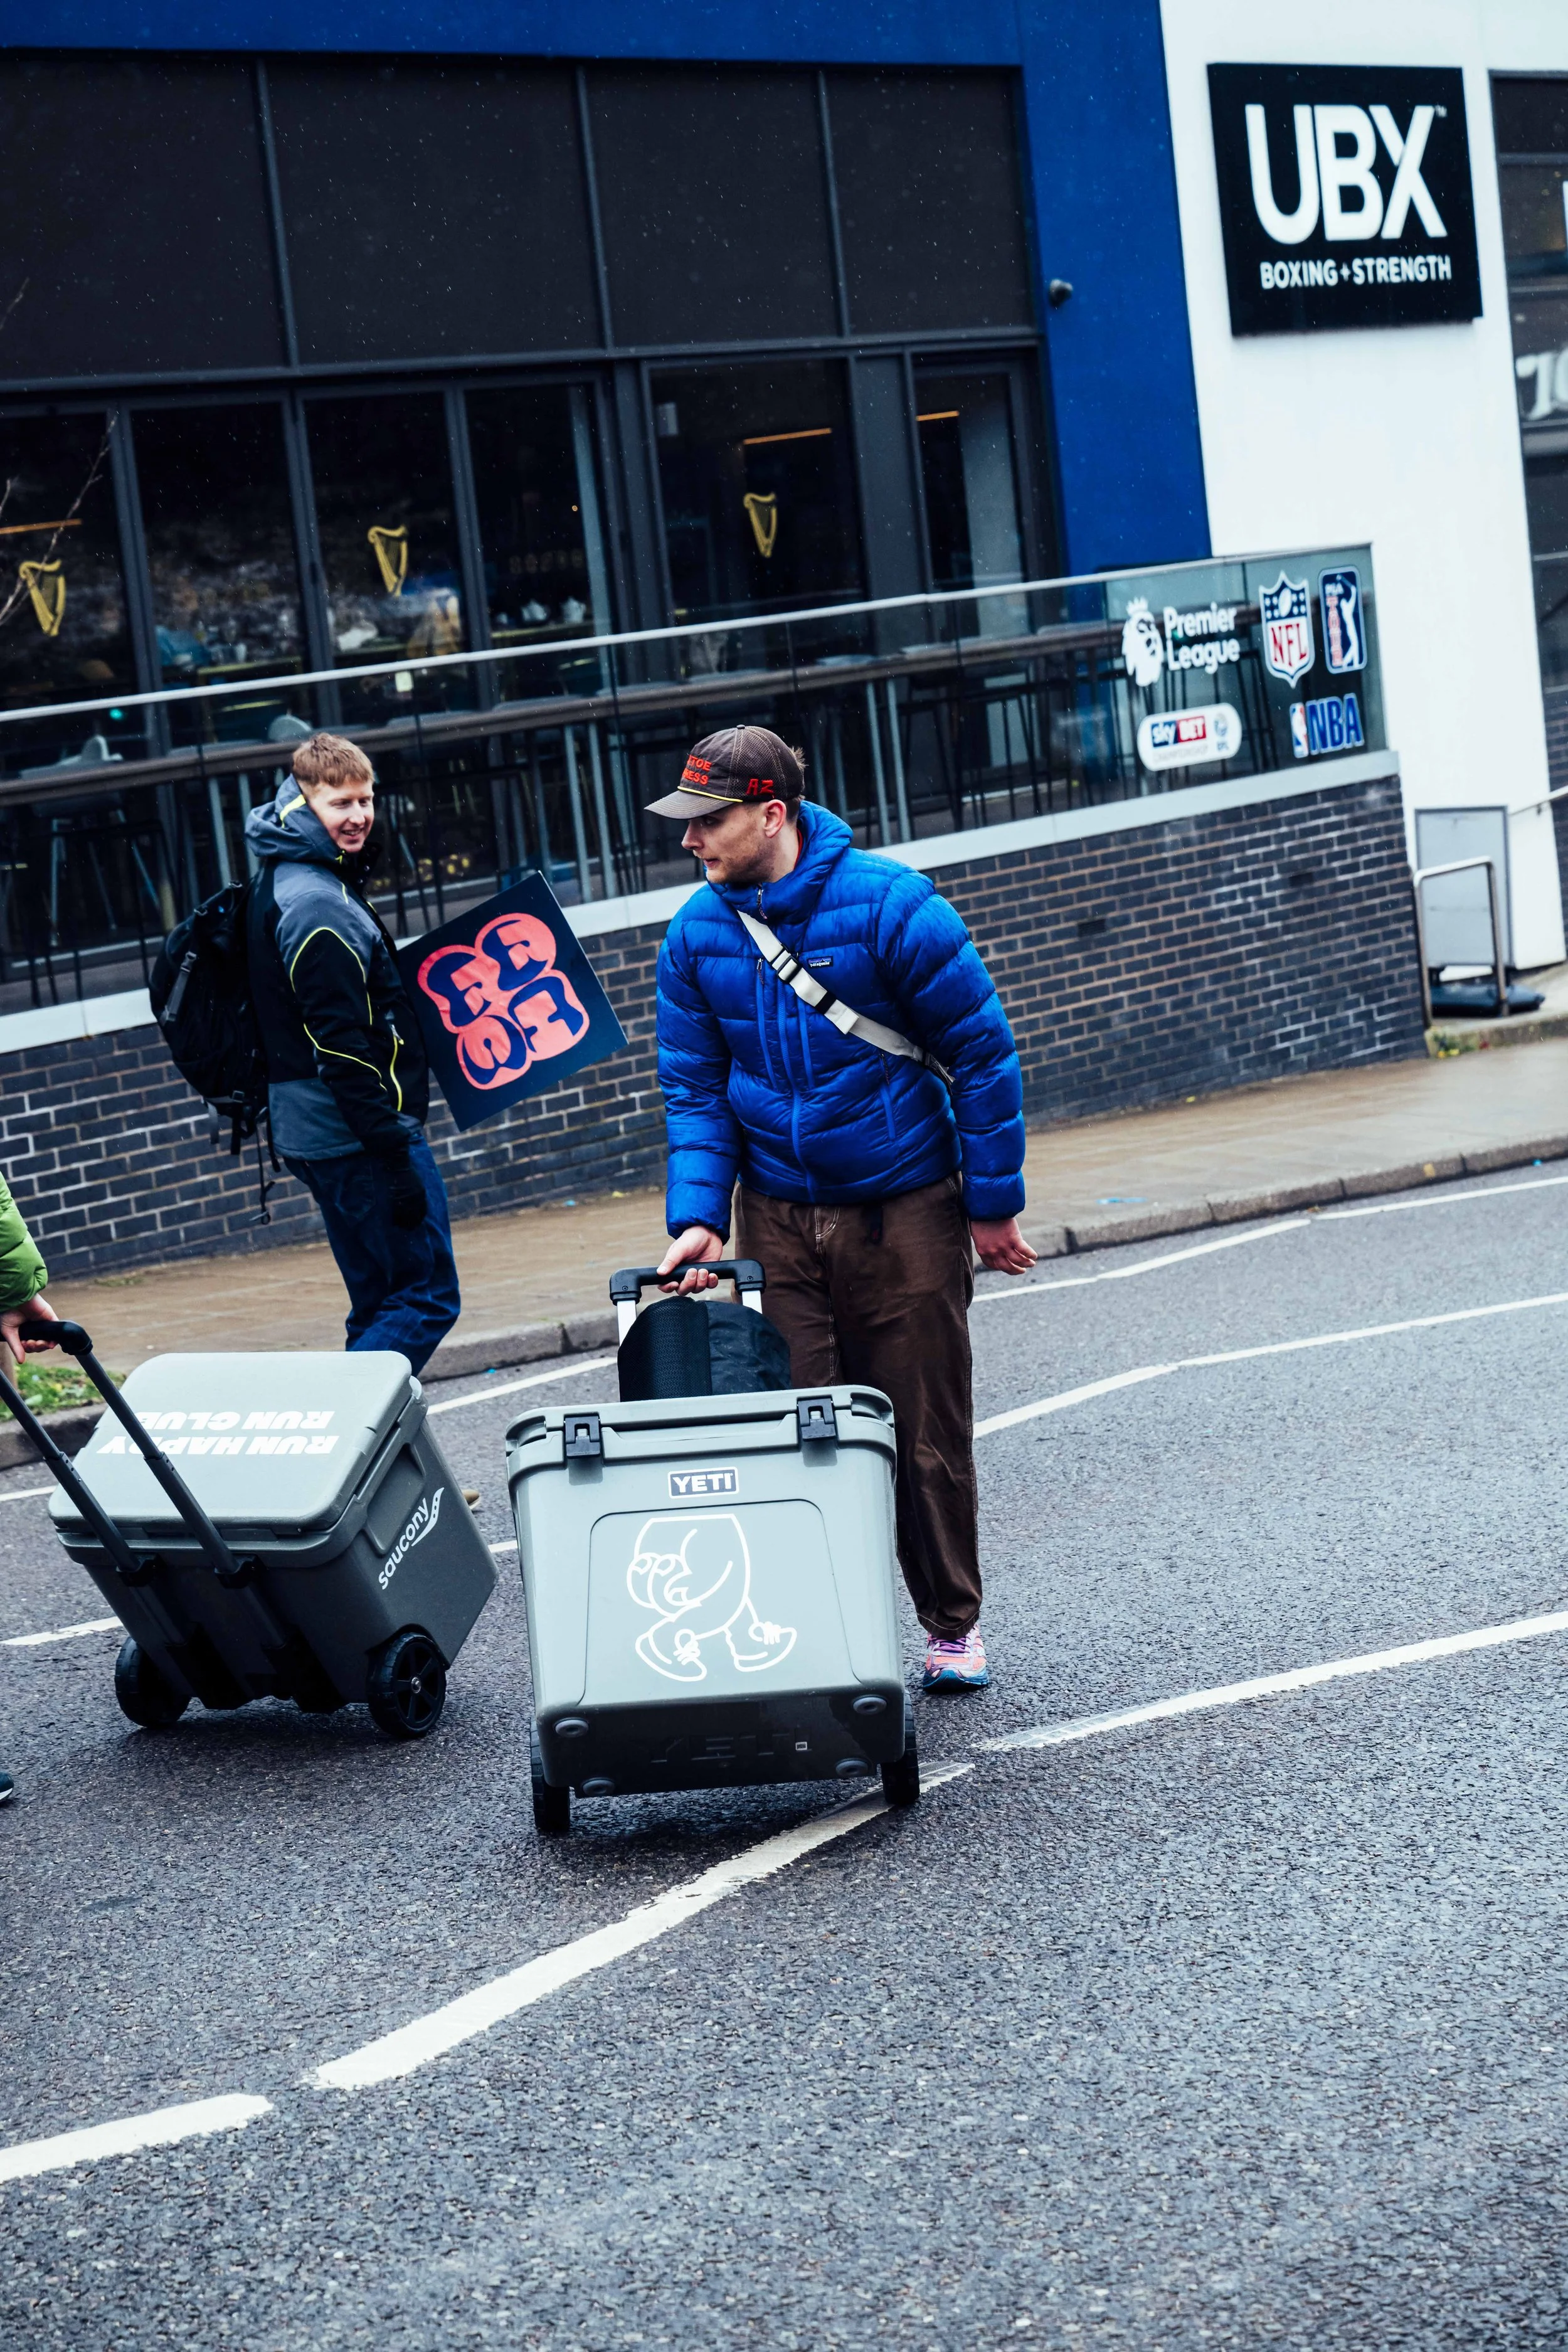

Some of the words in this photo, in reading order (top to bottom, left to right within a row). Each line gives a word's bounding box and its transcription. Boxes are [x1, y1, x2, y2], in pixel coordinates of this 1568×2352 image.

[1245, 103, 1448, 245] UBX
[1163, 601, 1237, 638] Premier
[1167, 638, 1241, 674] League
[1271, 622, 1308, 668] NFL
[1307, 694, 1364, 754] NBA
[241, 1411, 336, 1430] RUN
[245, 1435, 339, 1454] RUN
[672, 1473, 733, 1493] YETI
[378, 1497, 429, 1591] saucony
